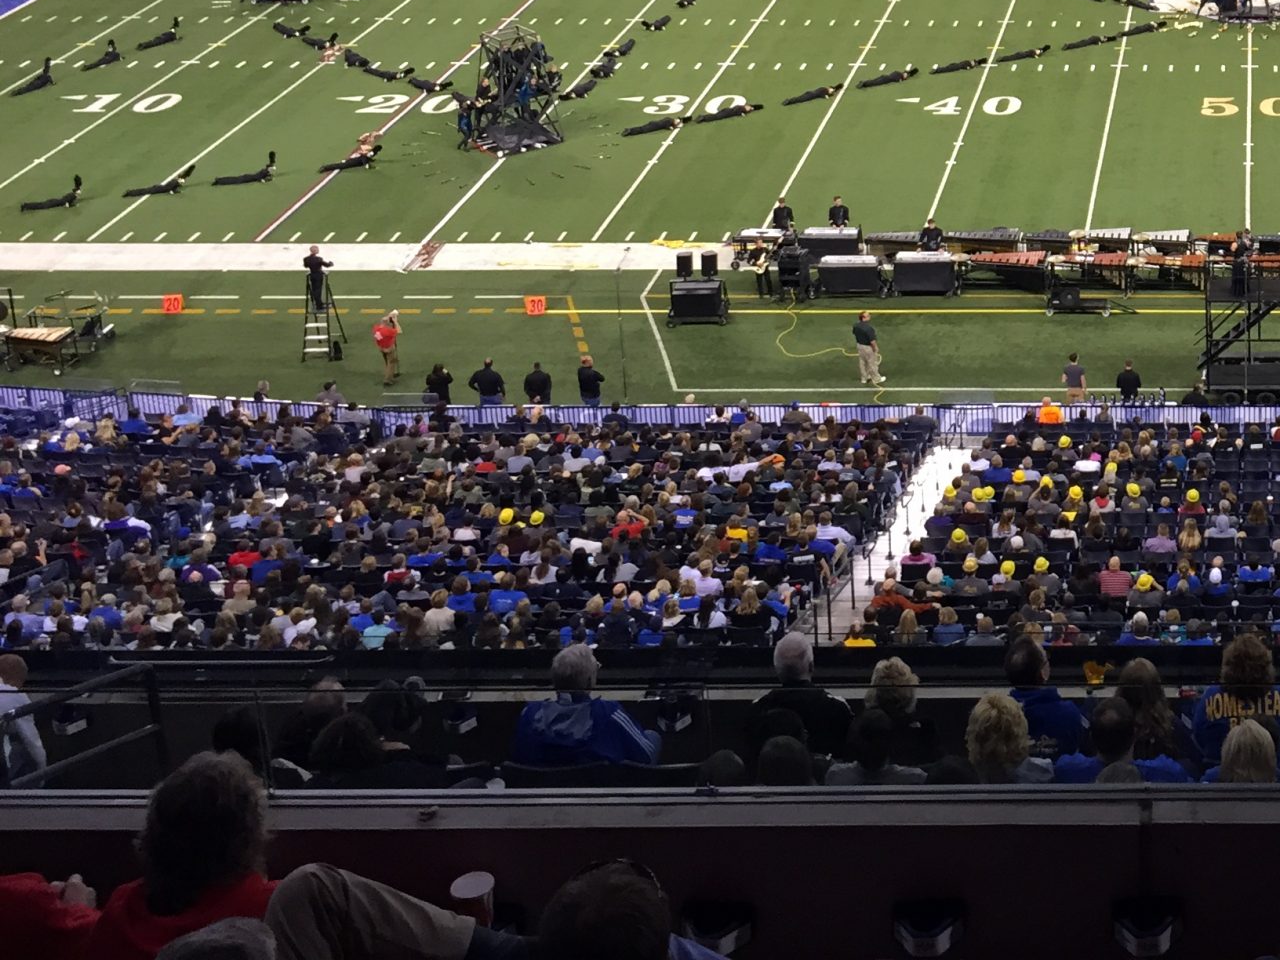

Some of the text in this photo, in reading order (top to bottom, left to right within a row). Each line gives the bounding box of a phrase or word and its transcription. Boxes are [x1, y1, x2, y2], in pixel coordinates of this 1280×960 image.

[72, 93, 183, 113] 10
[354, 94, 461, 114] 20
[642, 94, 748, 115] 30
[923, 95, 1022, 116] 40
[166, 297, 180, 311] 20
[531, 298, 543, 313] 30
